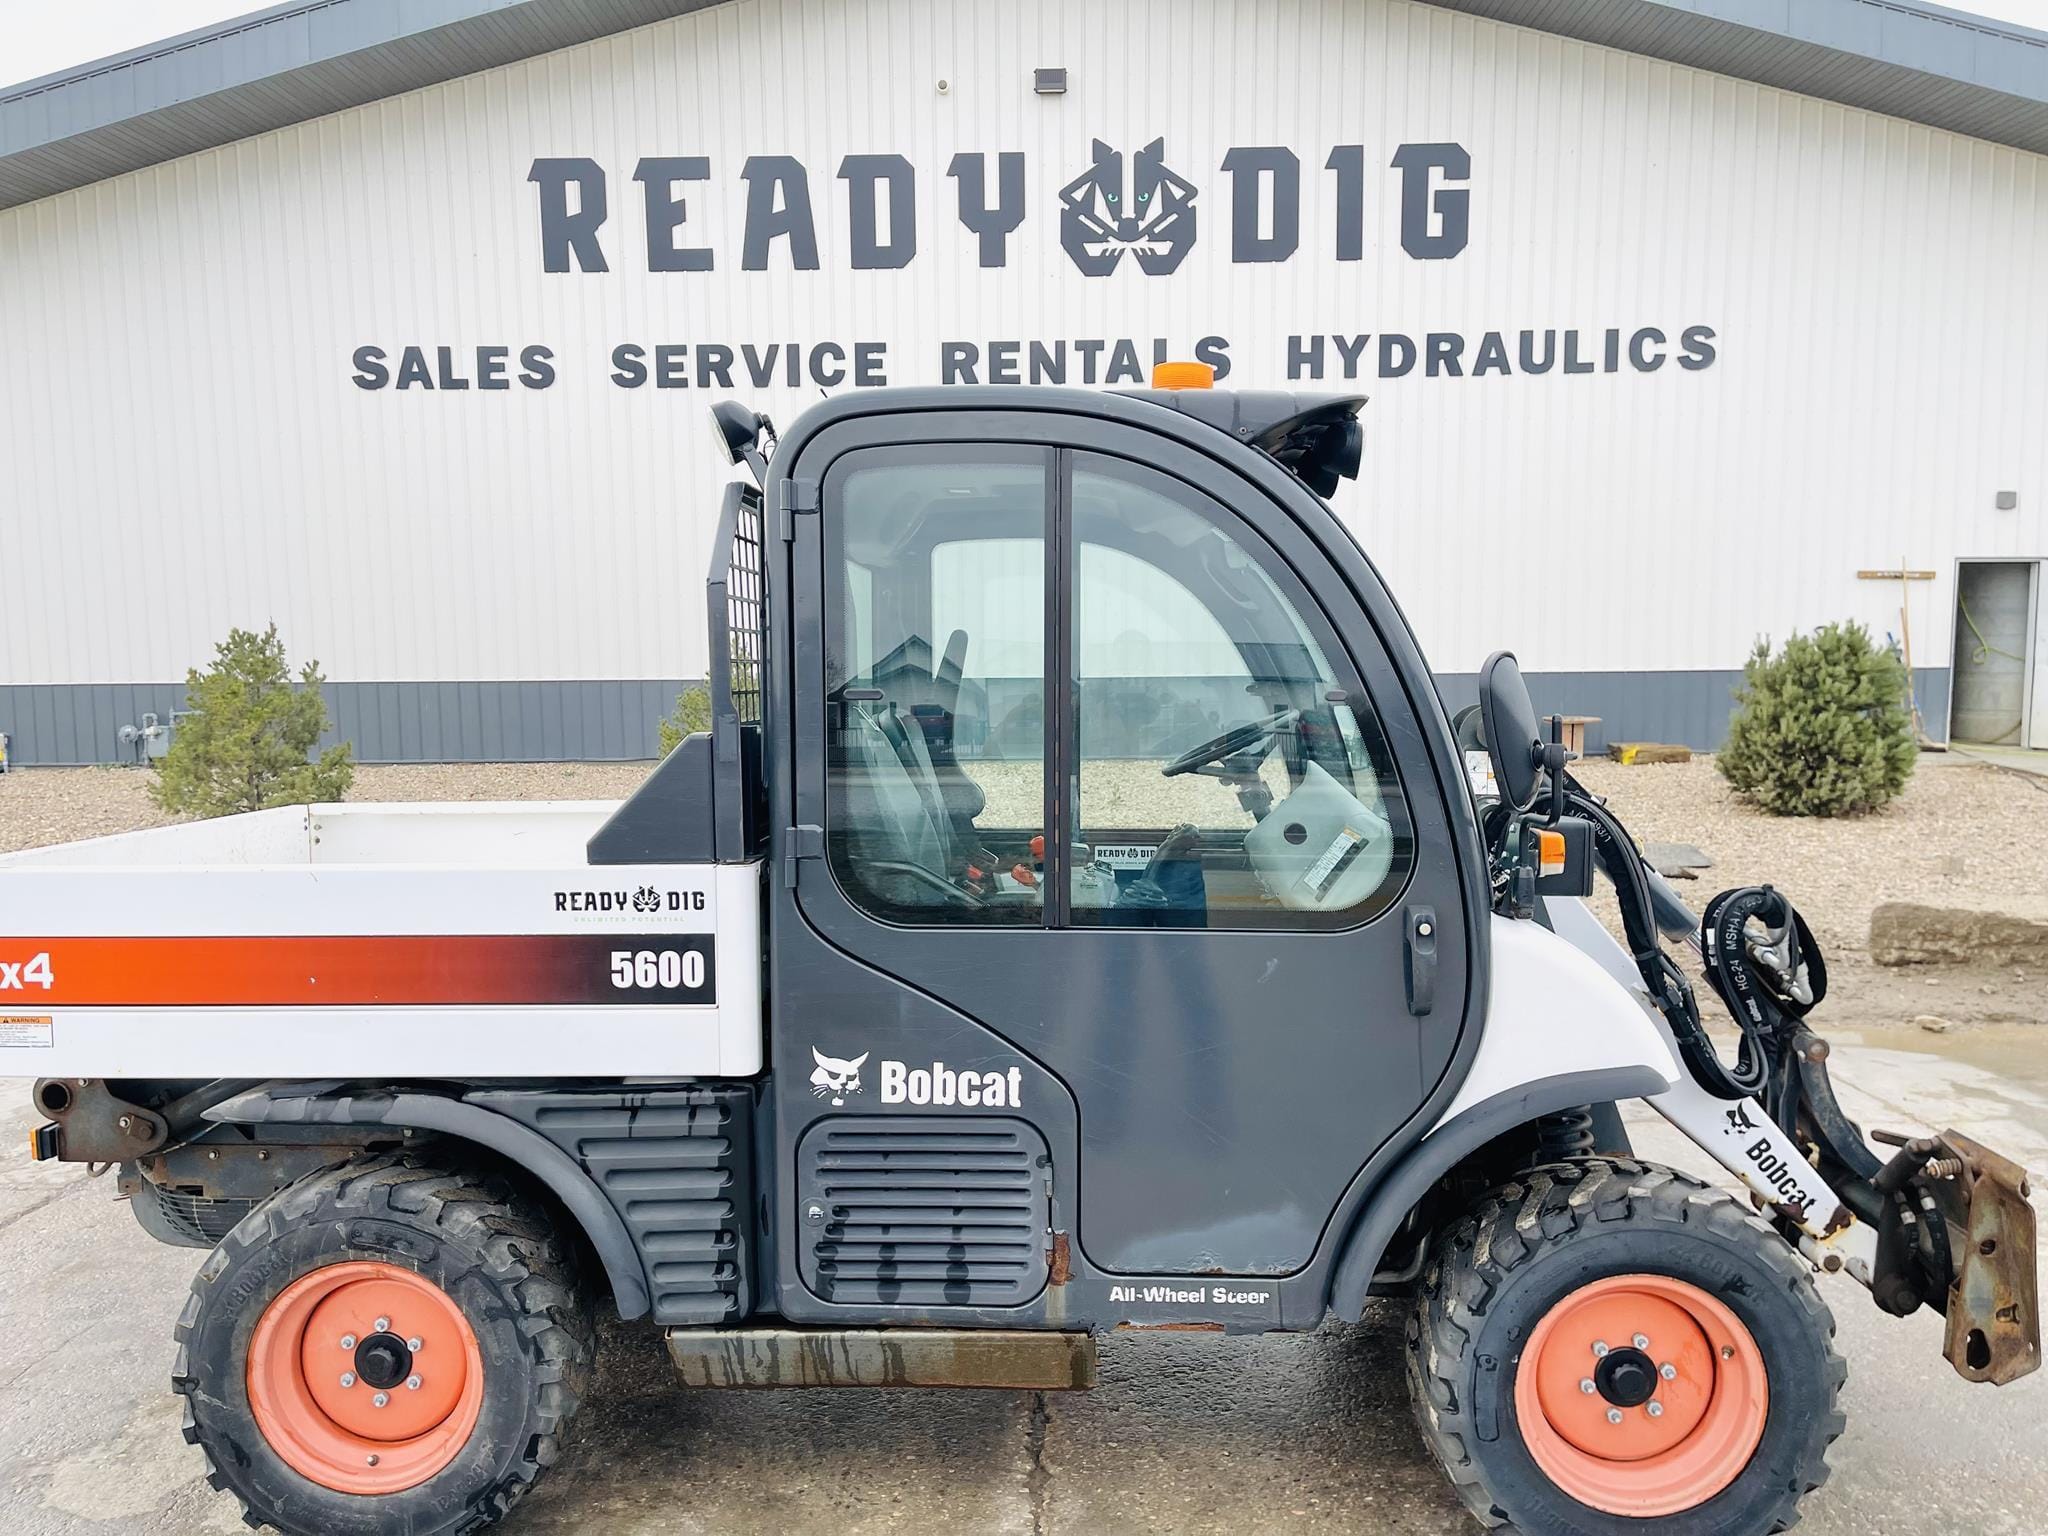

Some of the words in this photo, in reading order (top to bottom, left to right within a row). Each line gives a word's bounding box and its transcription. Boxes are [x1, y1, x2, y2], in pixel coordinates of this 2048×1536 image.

[527, 151, 1025, 273] READY
[1220, 142, 1471, 262] DIG
[351, 345, 555, 390] SALES
[610, 341, 888, 389] SERVICE
[1287, 325, 1717, 379] HYDRAULICS
[1097, 849, 1126, 858] READY
[553, 891, 628, 911] READY
[667, 891, 705, 911] DIG
[1725, 916, 1742, 950] MSHA
[611, 950, 705, 989] 5600
[1729, 959, 1750, 992] HG-24
[880, 1060, 1022, 1108] Bobcat
[1745, 1137, 1817, 1211] Bobcat
[1109, 1286, 1206, 1304] All-Wheel
[1212, 1287, 1270, 1305] Steer
